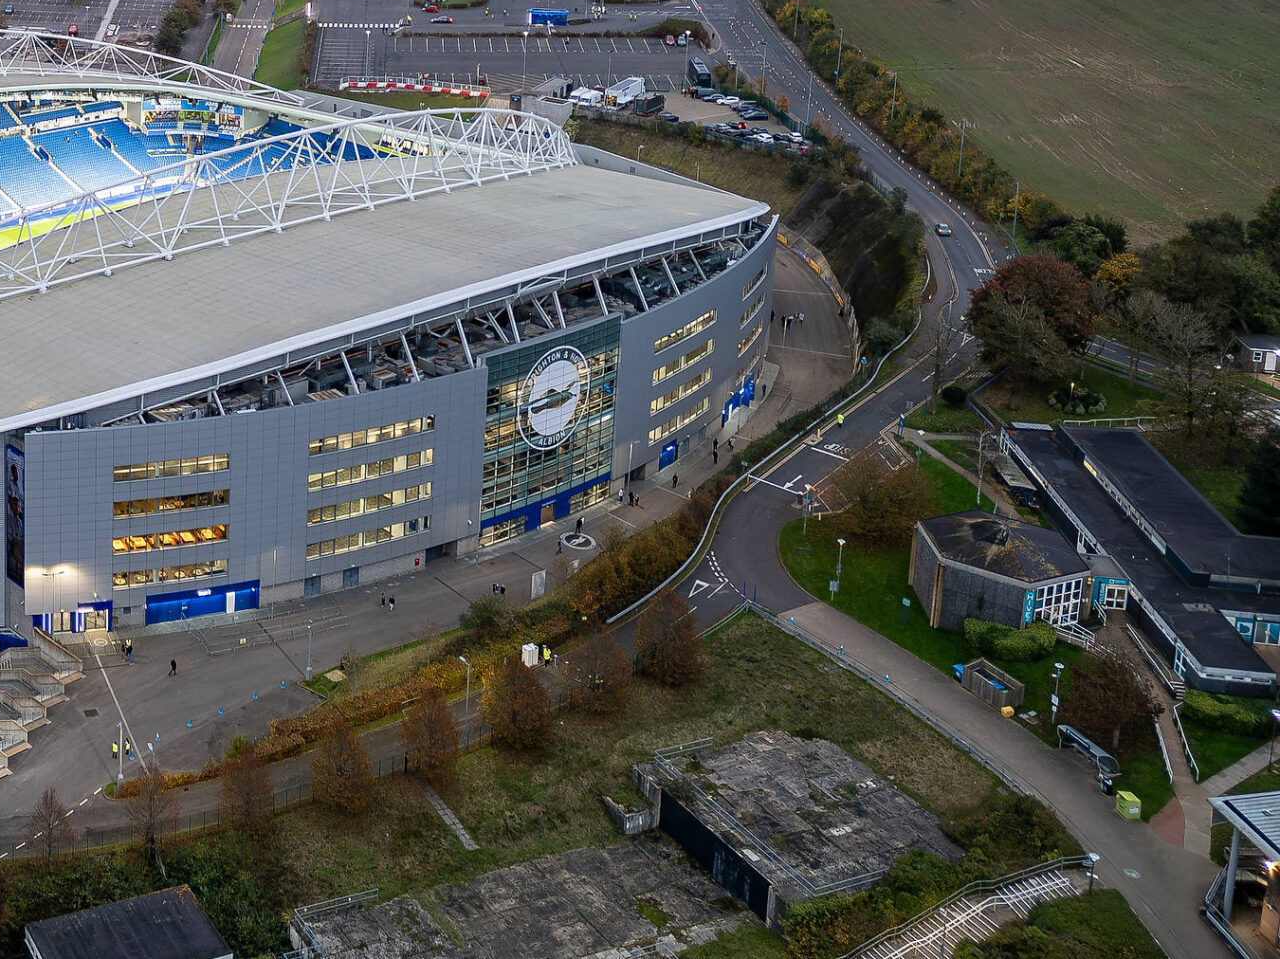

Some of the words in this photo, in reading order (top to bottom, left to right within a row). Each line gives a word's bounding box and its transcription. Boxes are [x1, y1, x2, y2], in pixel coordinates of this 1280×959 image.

[527, 352, 561, 386] BRIGHTON
[538, 429, 566, 446] ALBION
[1026, 593, 1034, 619] HIVE
